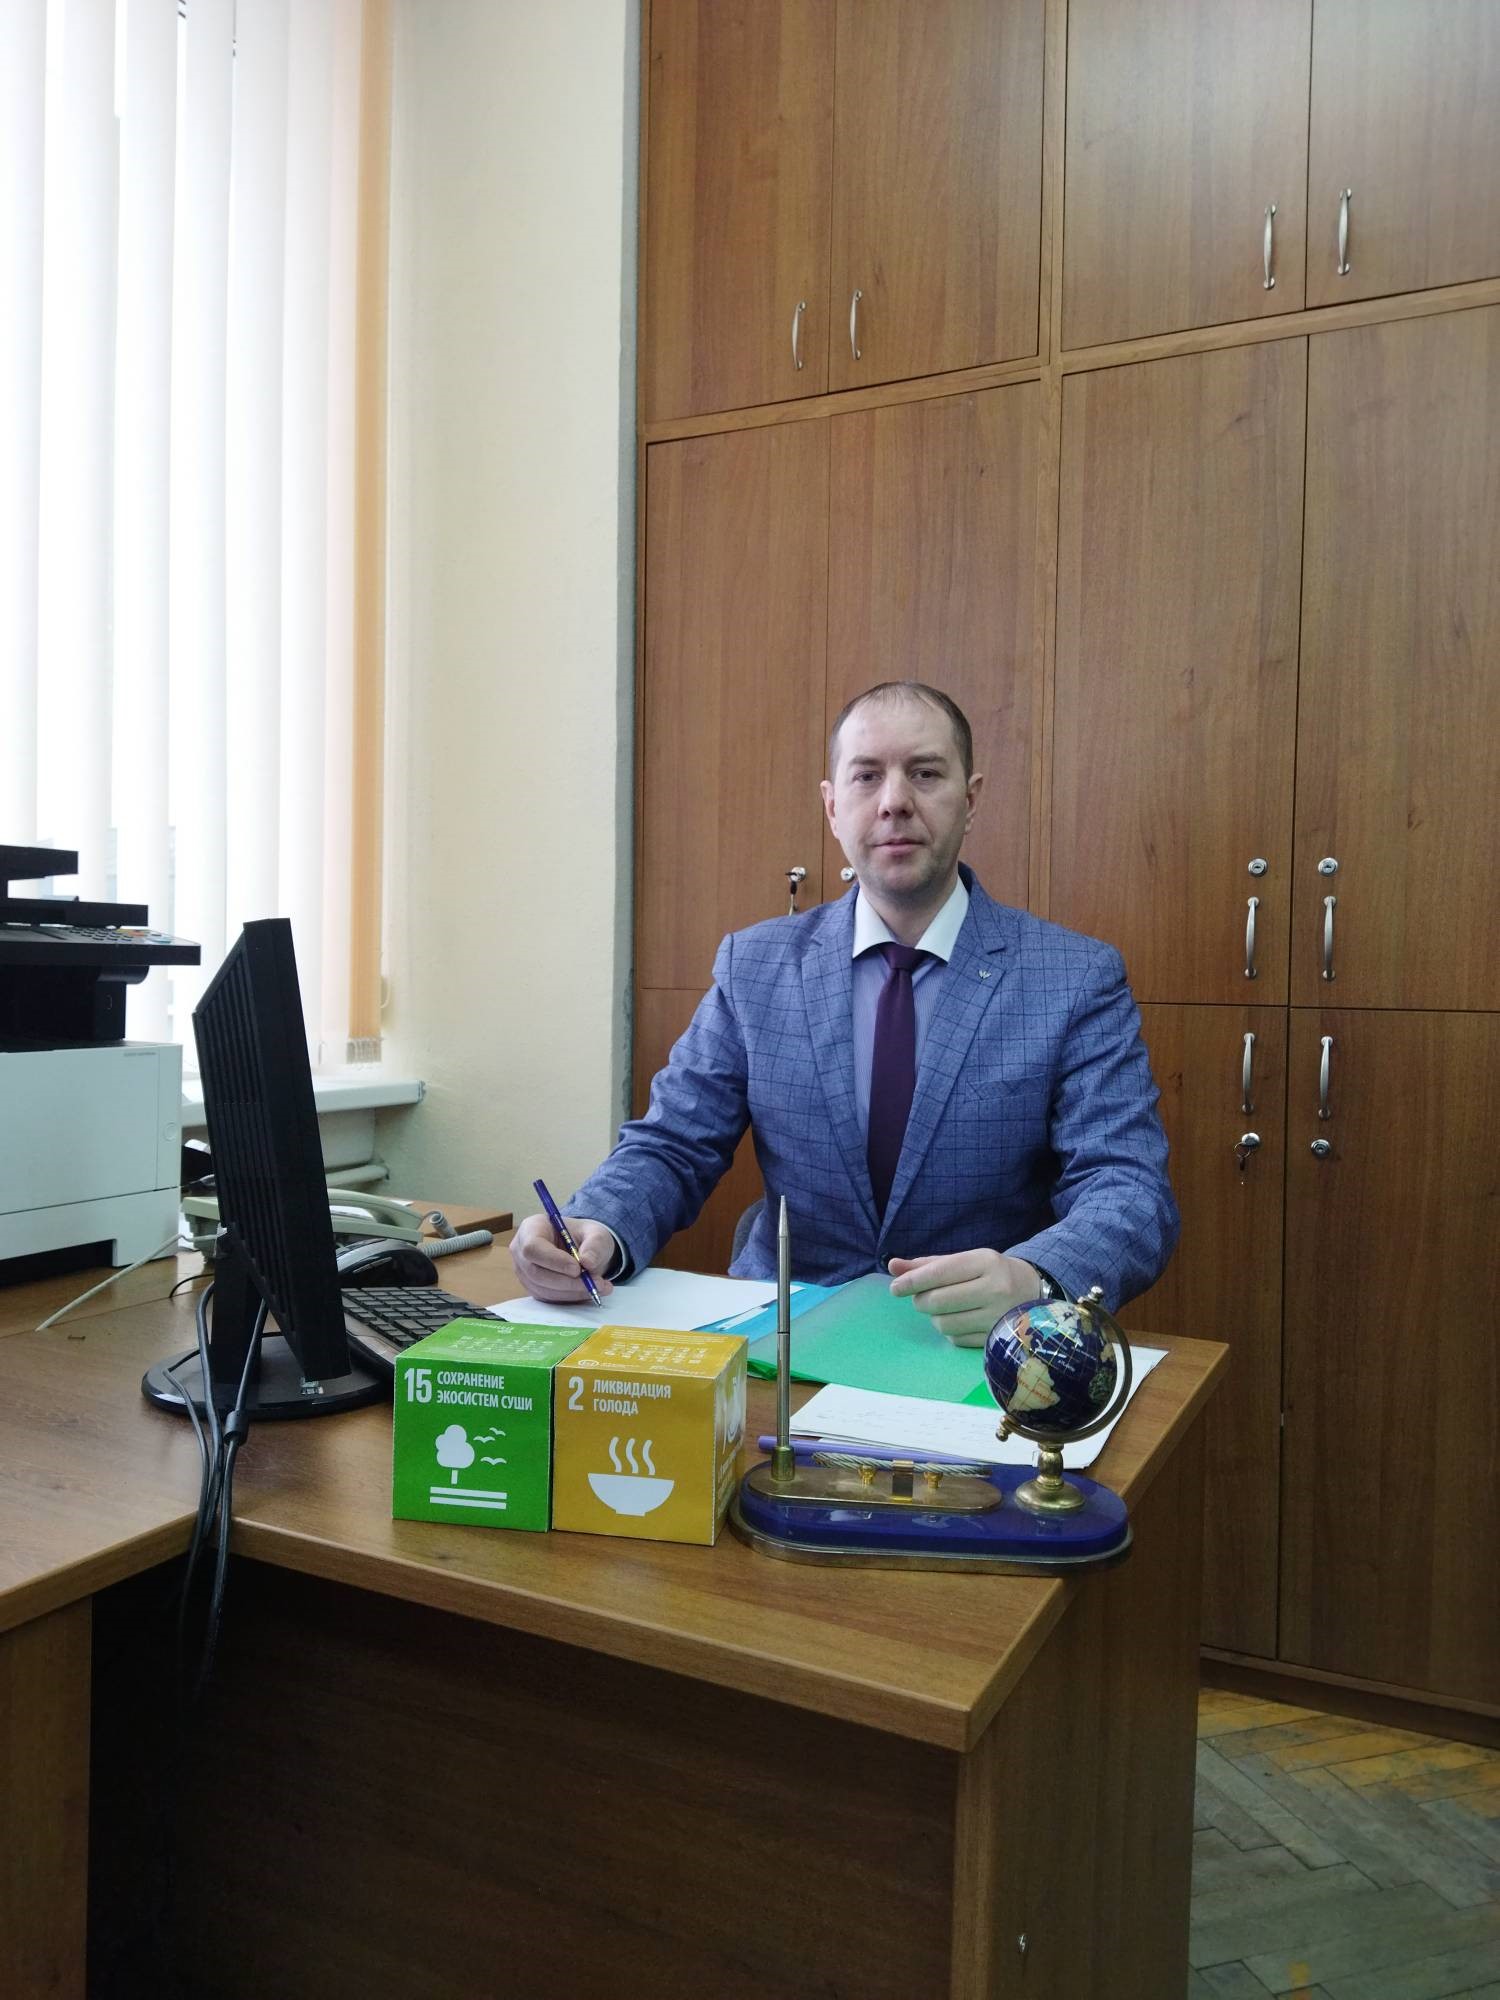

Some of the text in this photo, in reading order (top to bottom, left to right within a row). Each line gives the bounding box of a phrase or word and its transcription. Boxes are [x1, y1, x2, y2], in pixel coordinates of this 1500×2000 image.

[404, 1368, 432, 1403] 15
[437, 1371, 505, 1390] СОХРАНЕНИЕ
[593, 1379, 671, 1400] ЛИКВИДАЦИЯ
[436, 1390, 533, 1411] ЭКОСИСТЕМ СУШИ
[569, 1376, 584, 1411] 2
[593, 1398, 639, 1416] ГОЛОДА
